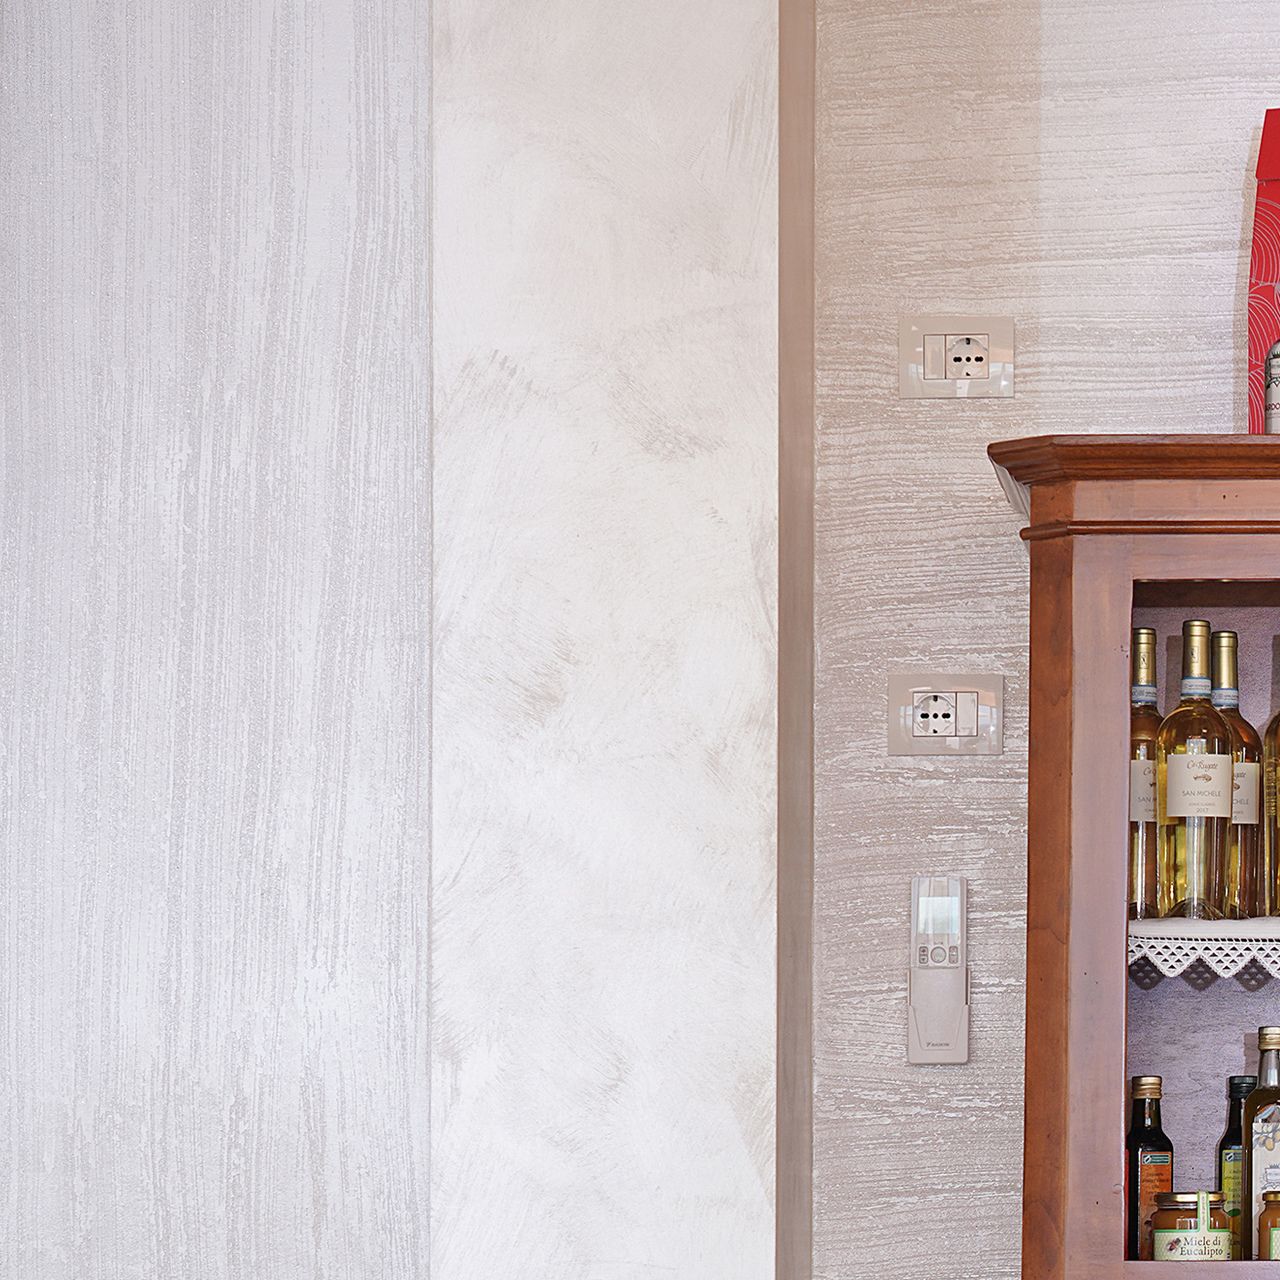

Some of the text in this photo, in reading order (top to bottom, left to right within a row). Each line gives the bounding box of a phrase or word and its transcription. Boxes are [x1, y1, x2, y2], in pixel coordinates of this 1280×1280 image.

[1183, 1236, 1221, 1246] Miele di
[1180, 1246, 1224, 1258] Eucalipto
